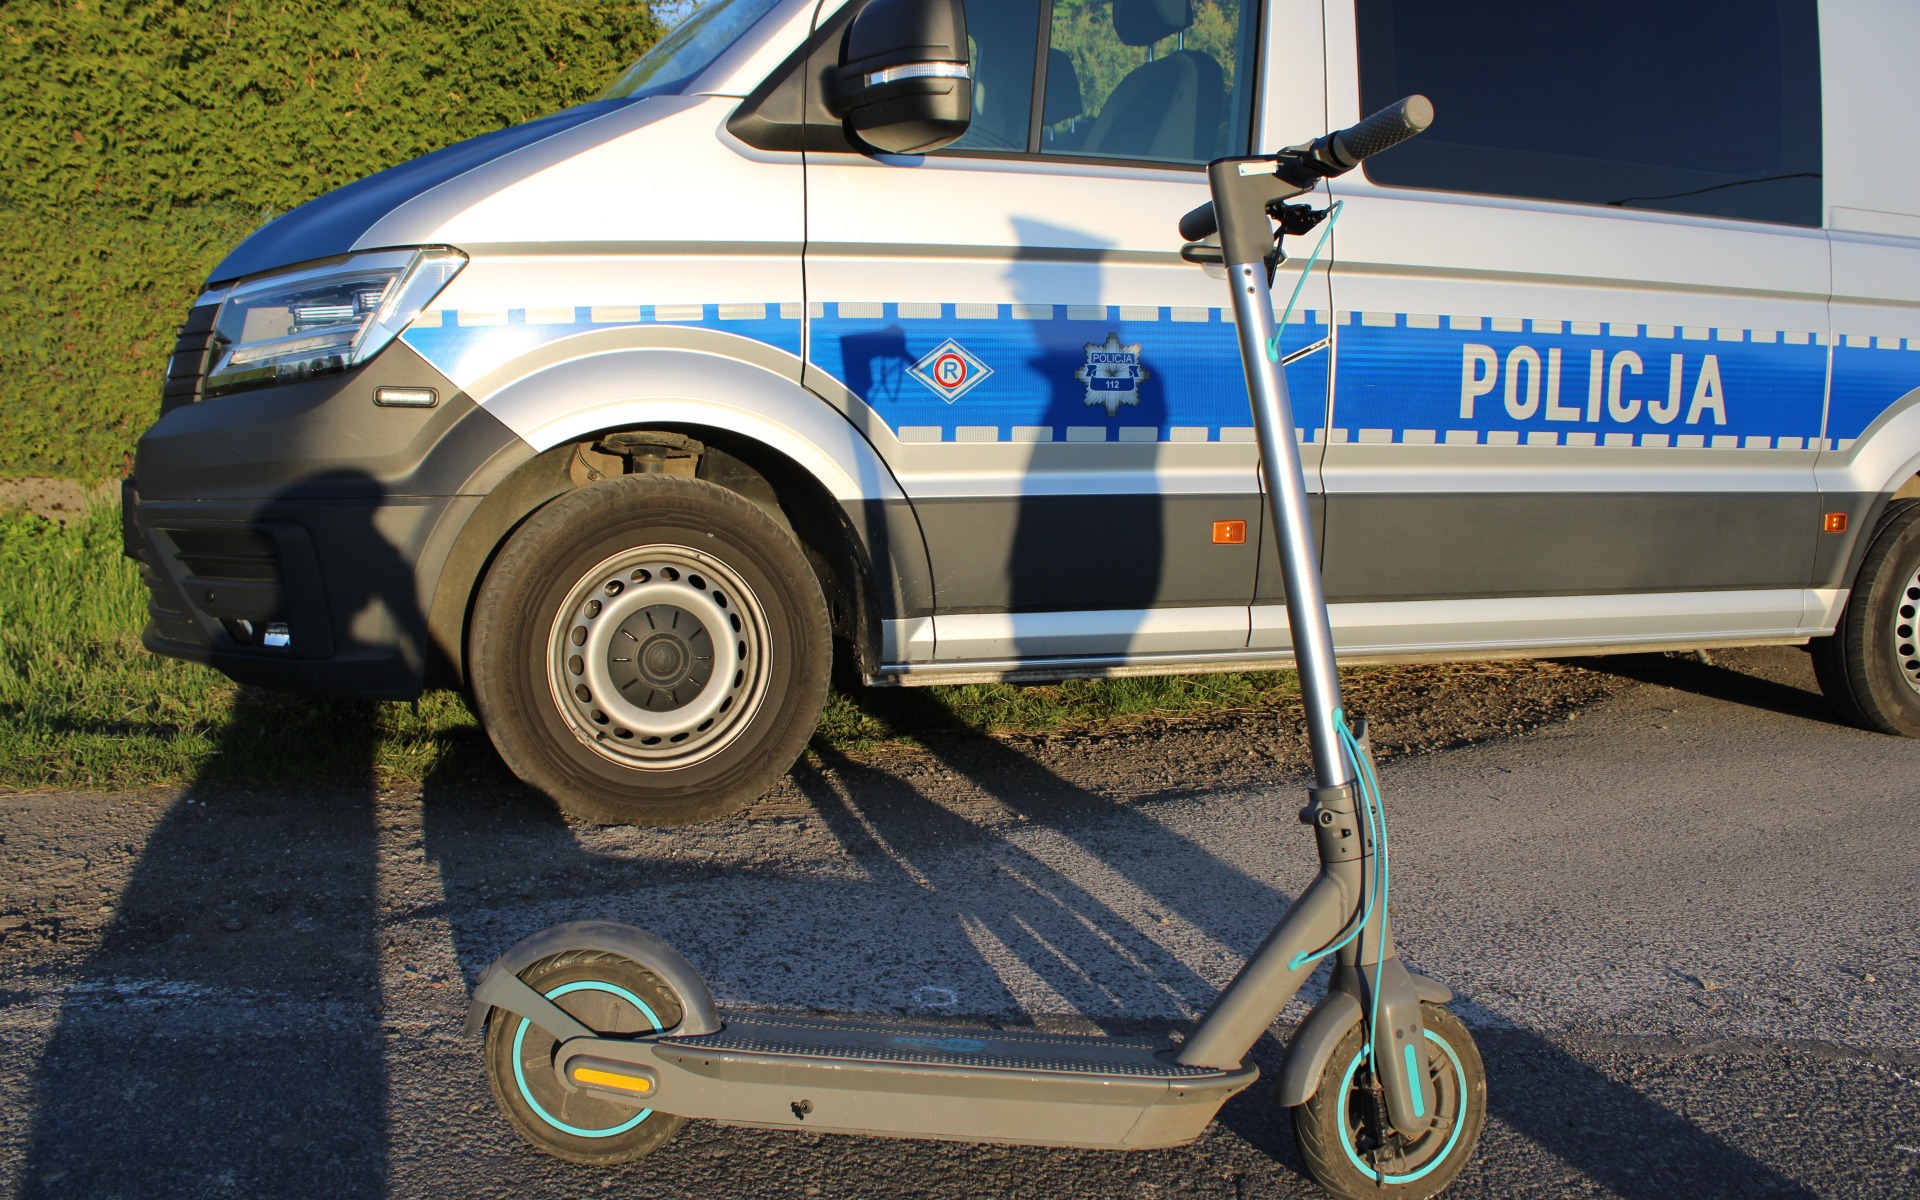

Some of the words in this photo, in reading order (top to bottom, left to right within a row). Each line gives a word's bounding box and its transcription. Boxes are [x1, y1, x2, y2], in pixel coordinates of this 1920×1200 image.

[1092, 353, 1133, 363] POLICJA
[943, 361, 959, 380] R
[1105, 380, 1120, 389] 112
[1459, 343, 1727, 425] POLICJA
